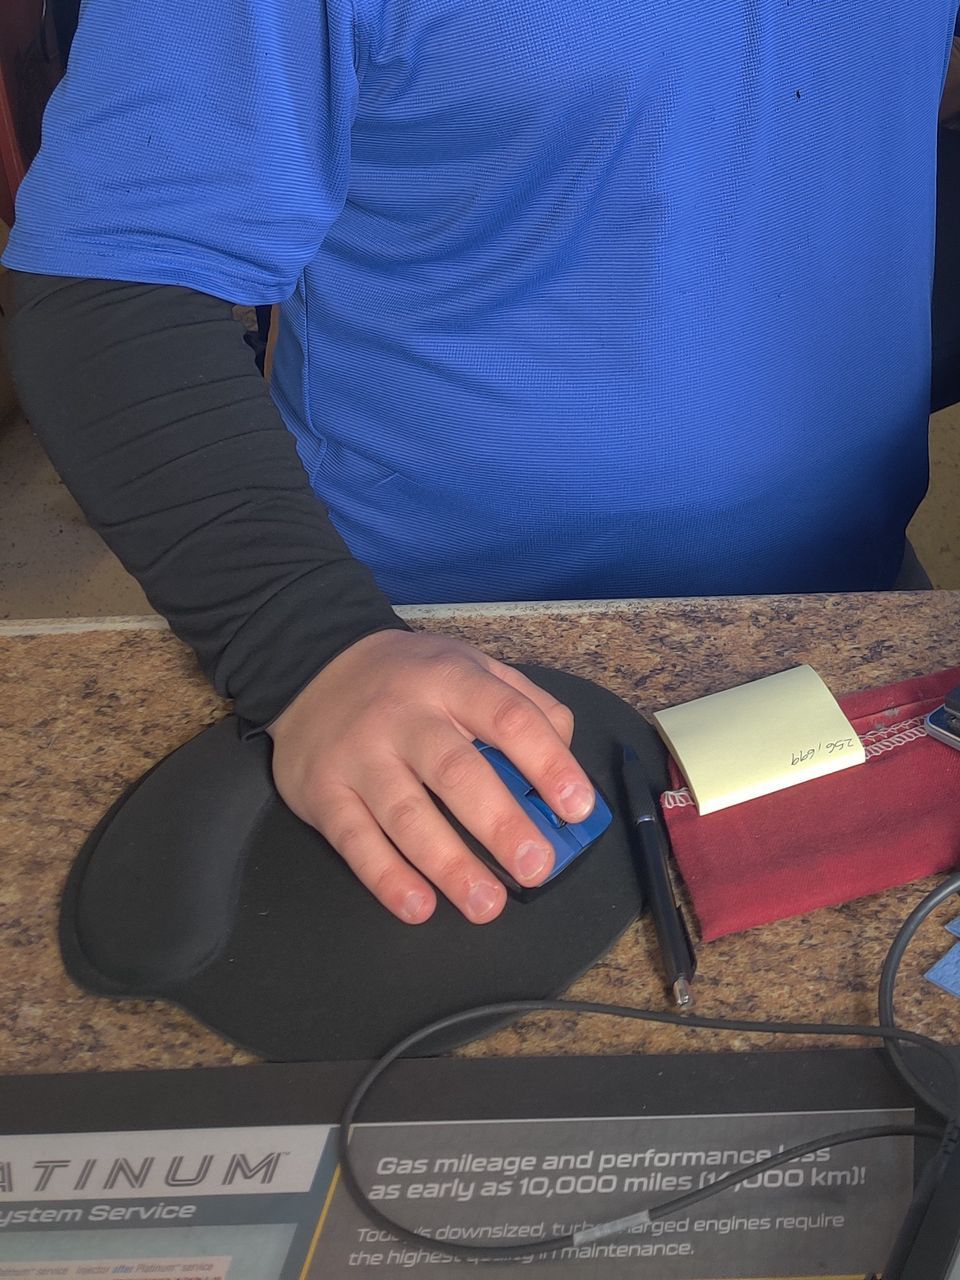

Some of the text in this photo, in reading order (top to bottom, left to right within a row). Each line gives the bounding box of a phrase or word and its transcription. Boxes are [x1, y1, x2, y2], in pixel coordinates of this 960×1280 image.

[376, 1157, 429, 1176] Gas
[433, 1153, 537, 1177] mileage
[541, 1151, 594, 1170] and
[598, 1148, 772, 1173] performance
[368, 1183, 401, 1200] as
[406, 1178, 476, 1202] early
[480, 1180, 512, 1197] as
[519, 1174, 617, 1198] 10,000
[623, 1172, 693, 1193] miles
[811, 1166, 866, 1187] km)!
[88, 1201, 197, 1222] Service
[435, 1222, 547, 1243] downsized,
[693, 1215, 771, 1234] engines
[775, 1212, 845, 1232] require
[349, 1249, 384, 1266] the
[561, 1242, 695, 1259] maintenance.
